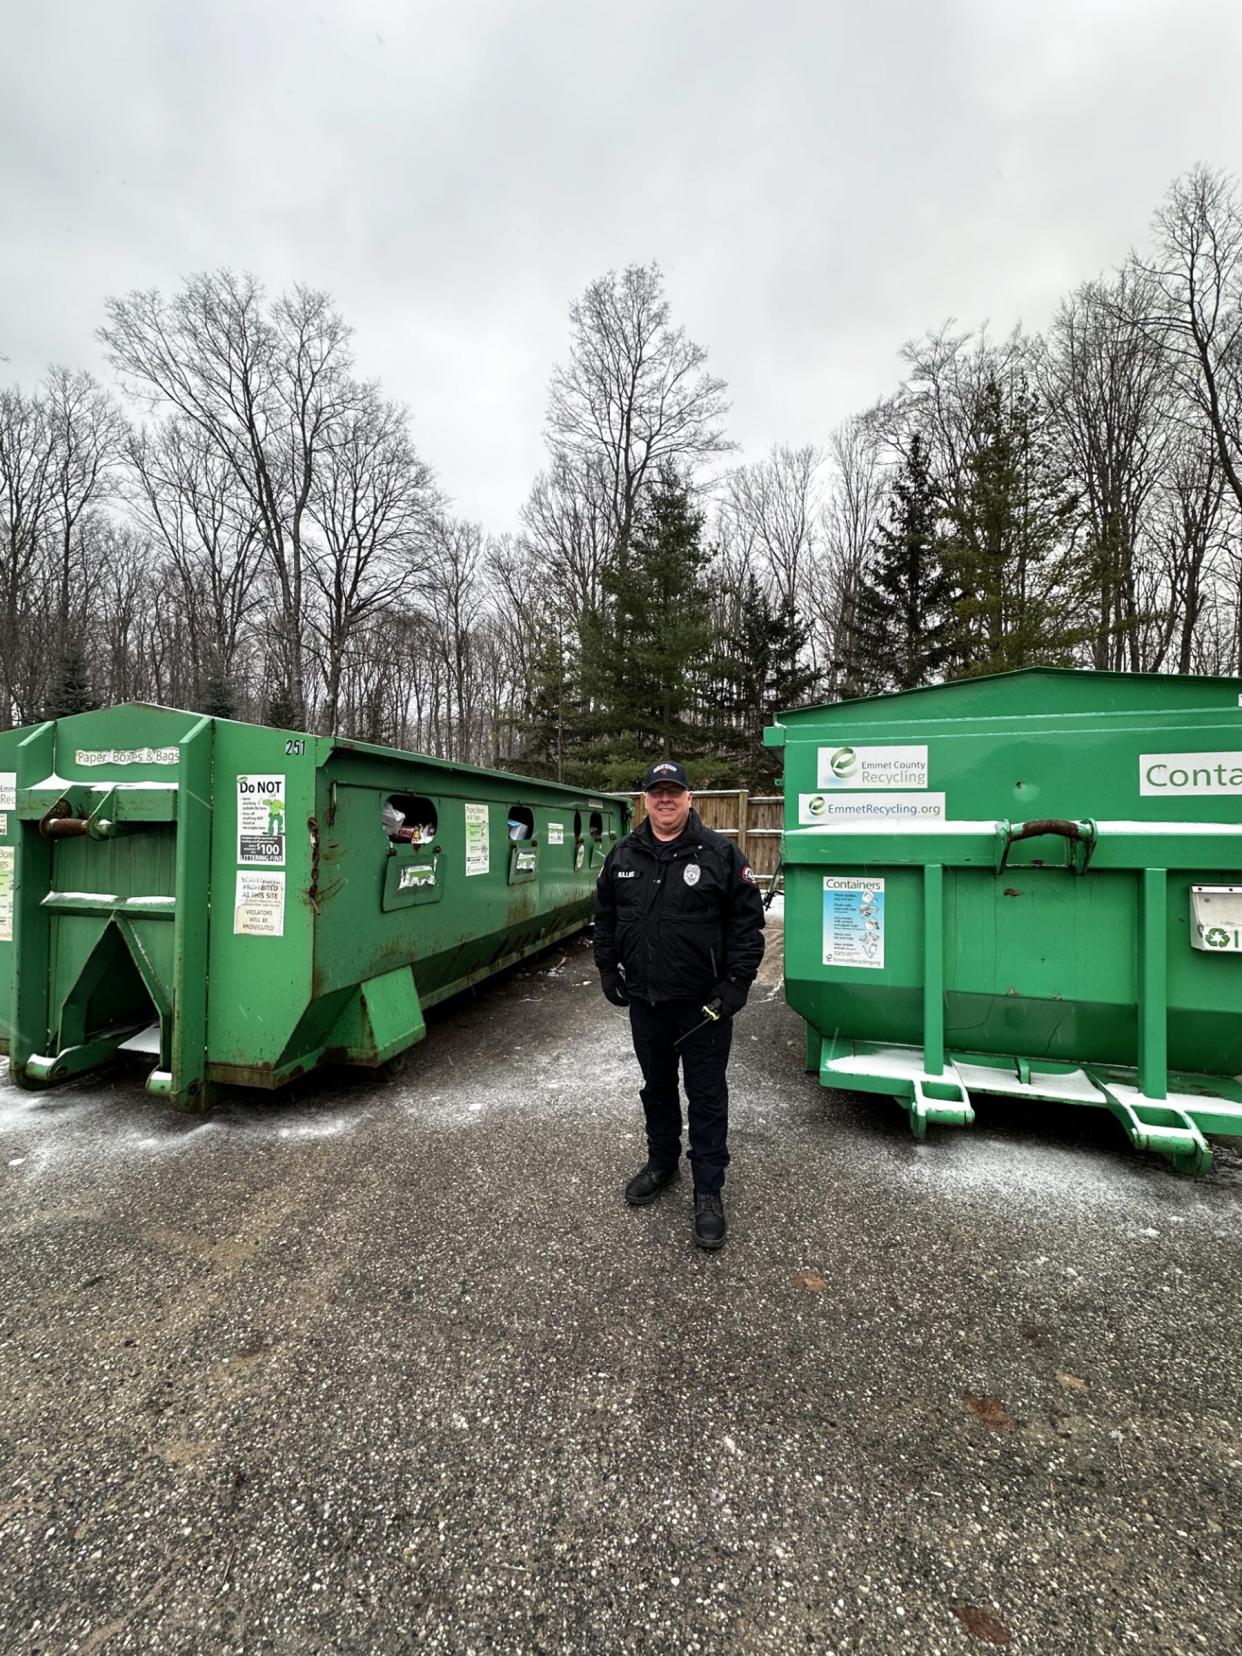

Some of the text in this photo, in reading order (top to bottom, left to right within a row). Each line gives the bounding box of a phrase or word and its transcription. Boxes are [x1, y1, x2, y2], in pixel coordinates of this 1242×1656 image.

[286, 739, 305, 756] 251
[112, 751, 142, 762] Boxes
[146, 751, 153, 761] &
[156, 750, 179, 763] Bags
[861, 760, 926, 770] Emmet County
[862, 770, 926, 785] Recycling
[1146, 763, 1242, 787] Conta
[240, 781, 282, 793] Do NOT
[828, 803, 941, 816] EmmetRecycling.org
[256, 843, 280, 855] $100
[826, 879, 881, 890] Containers
